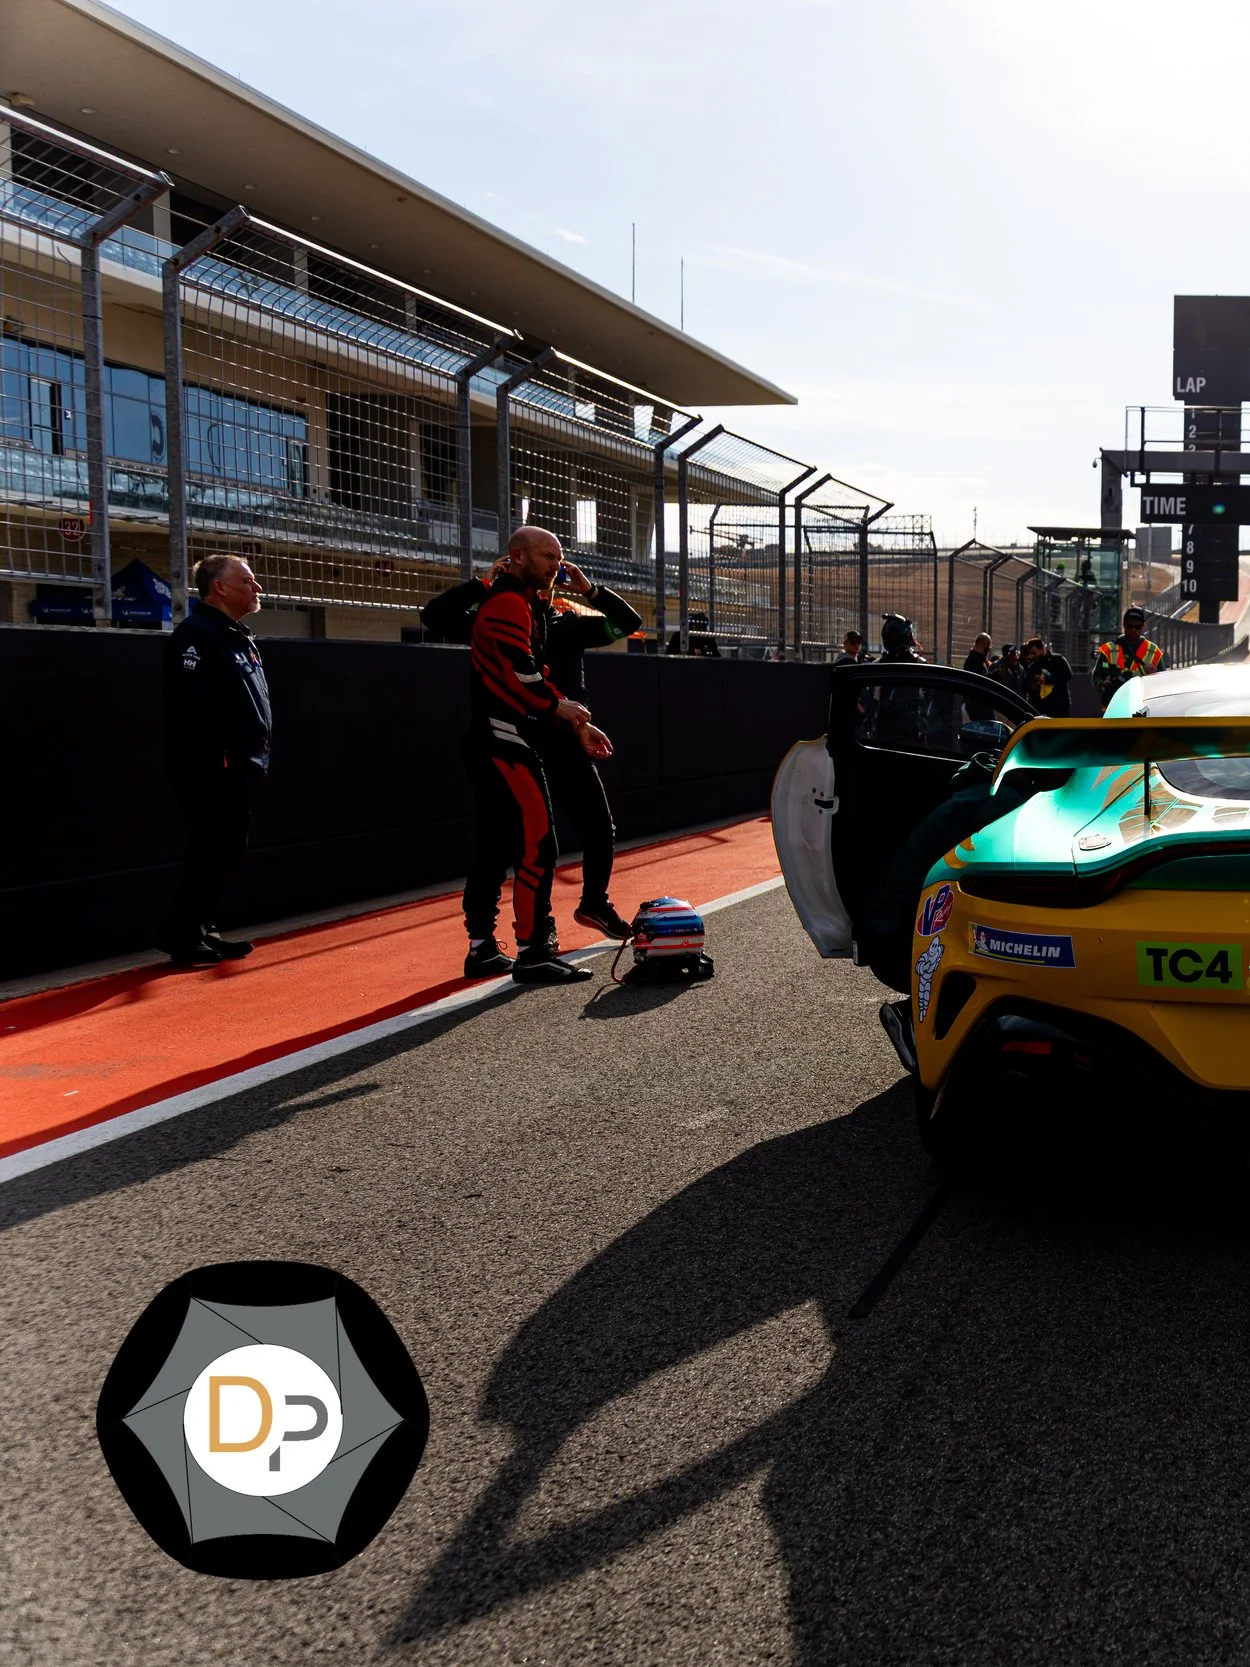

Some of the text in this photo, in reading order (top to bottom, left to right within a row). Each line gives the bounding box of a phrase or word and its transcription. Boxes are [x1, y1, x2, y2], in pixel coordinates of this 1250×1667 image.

[1176, 377, 1206, 393] LAP
[1188, 425, 1197, 438] 2
[1143, 496, 1187, 516] TIME
[64, 521, 80, 536] 32
[1186, 541, 1194, 554] 8
[1186, 560, 1194, 574] 9
[1182, 579, 1197, 593] 10
[922, 884, 951, 935] VP
[989, 938, 1061, 958] MICHELIN
[1146, 947, 1232, 983] TC4
